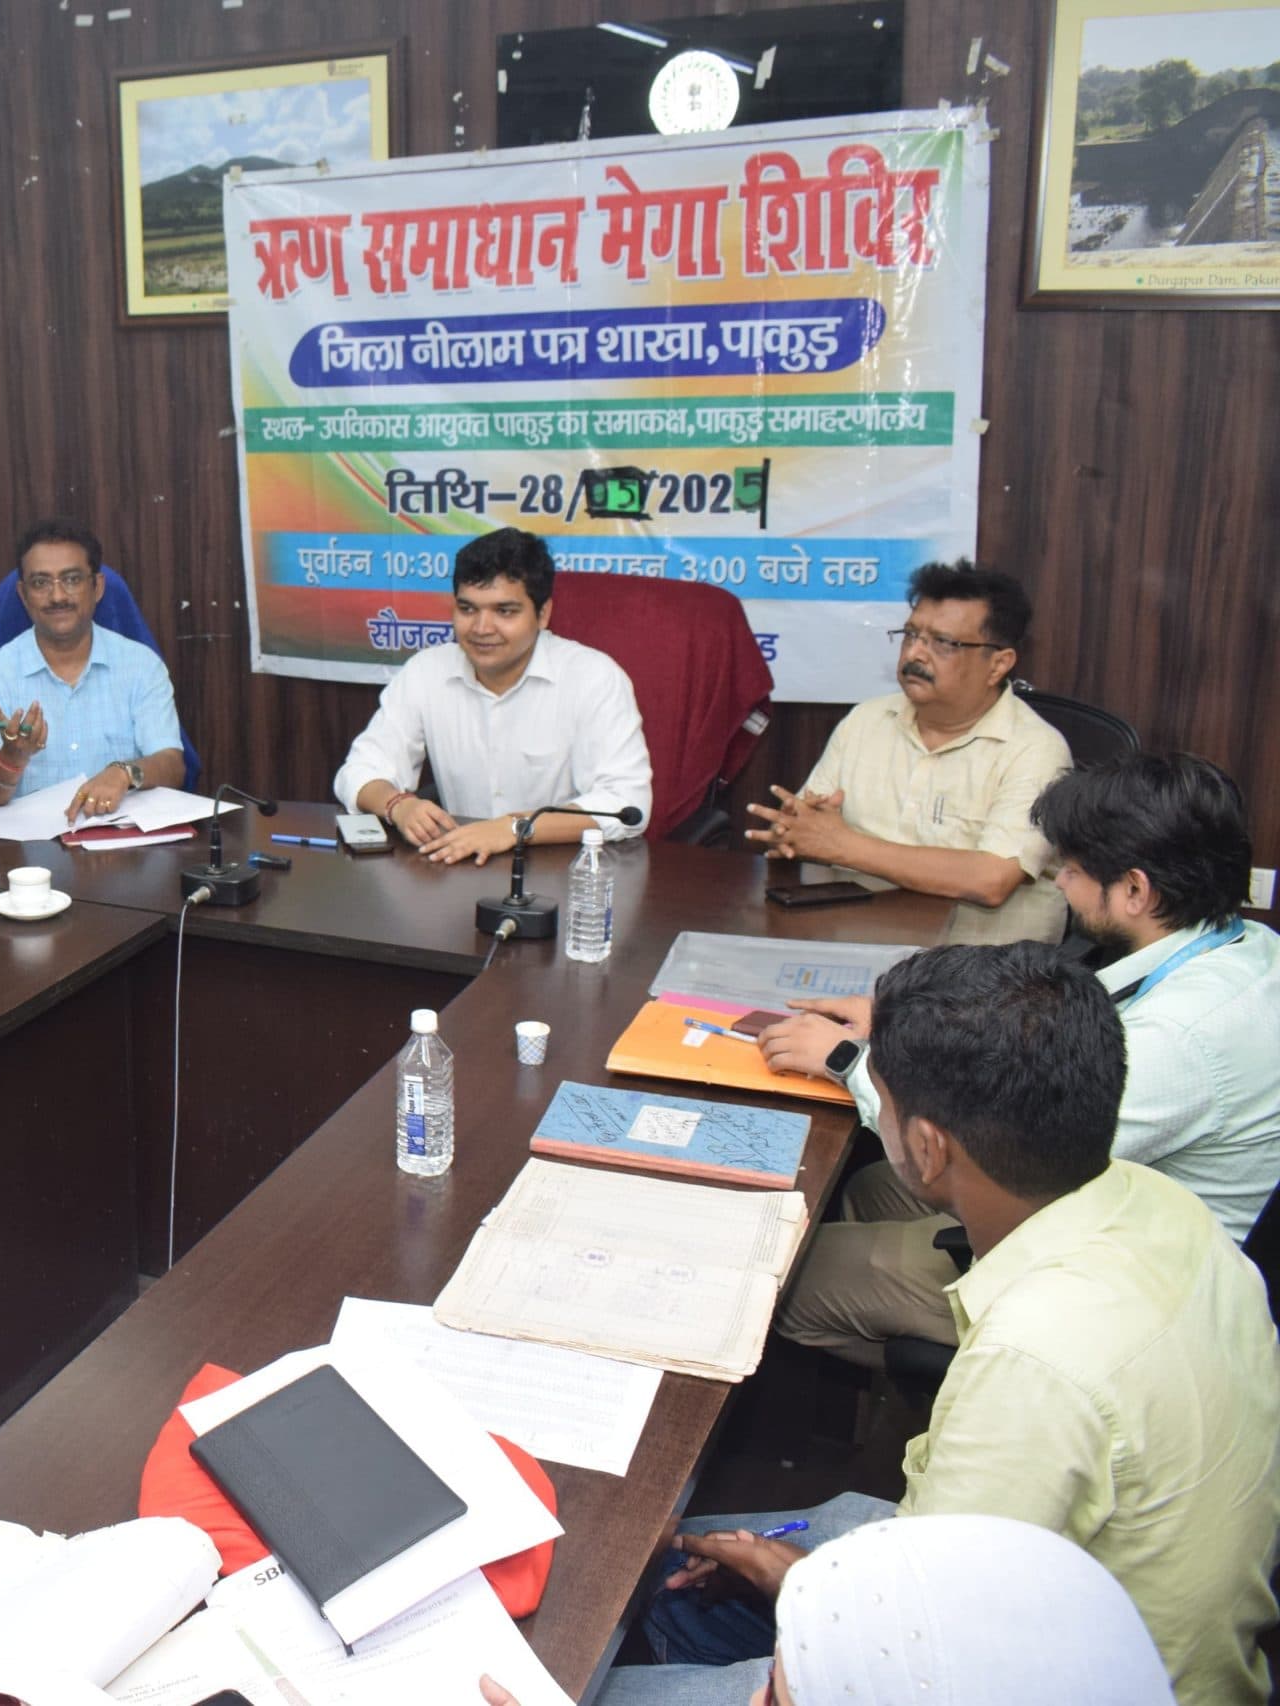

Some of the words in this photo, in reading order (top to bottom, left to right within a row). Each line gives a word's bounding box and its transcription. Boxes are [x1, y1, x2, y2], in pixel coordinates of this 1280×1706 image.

[249, 214, 353, 301] ऋण
[361, 196, 585, 295] समाधान
[596, 165, 729, 280] मेगा
[739, 143, 939, 275] शिविर
[319, 326, 406, 372] जिला
[410, 321, 525, 369] नीलाम
[531, 327, 588, 363] पत्र
[493, 411, 555, 446] पाकुड़
[556, 411, 589, 435] का
[382, 550, 449, 577] 10:30
[679, 555, 746, 583] 3:00
[756, 544, 811, 586] बजे
[821, 556, 880, 586] तक
[253, 1562, 286, 1587] SBI
